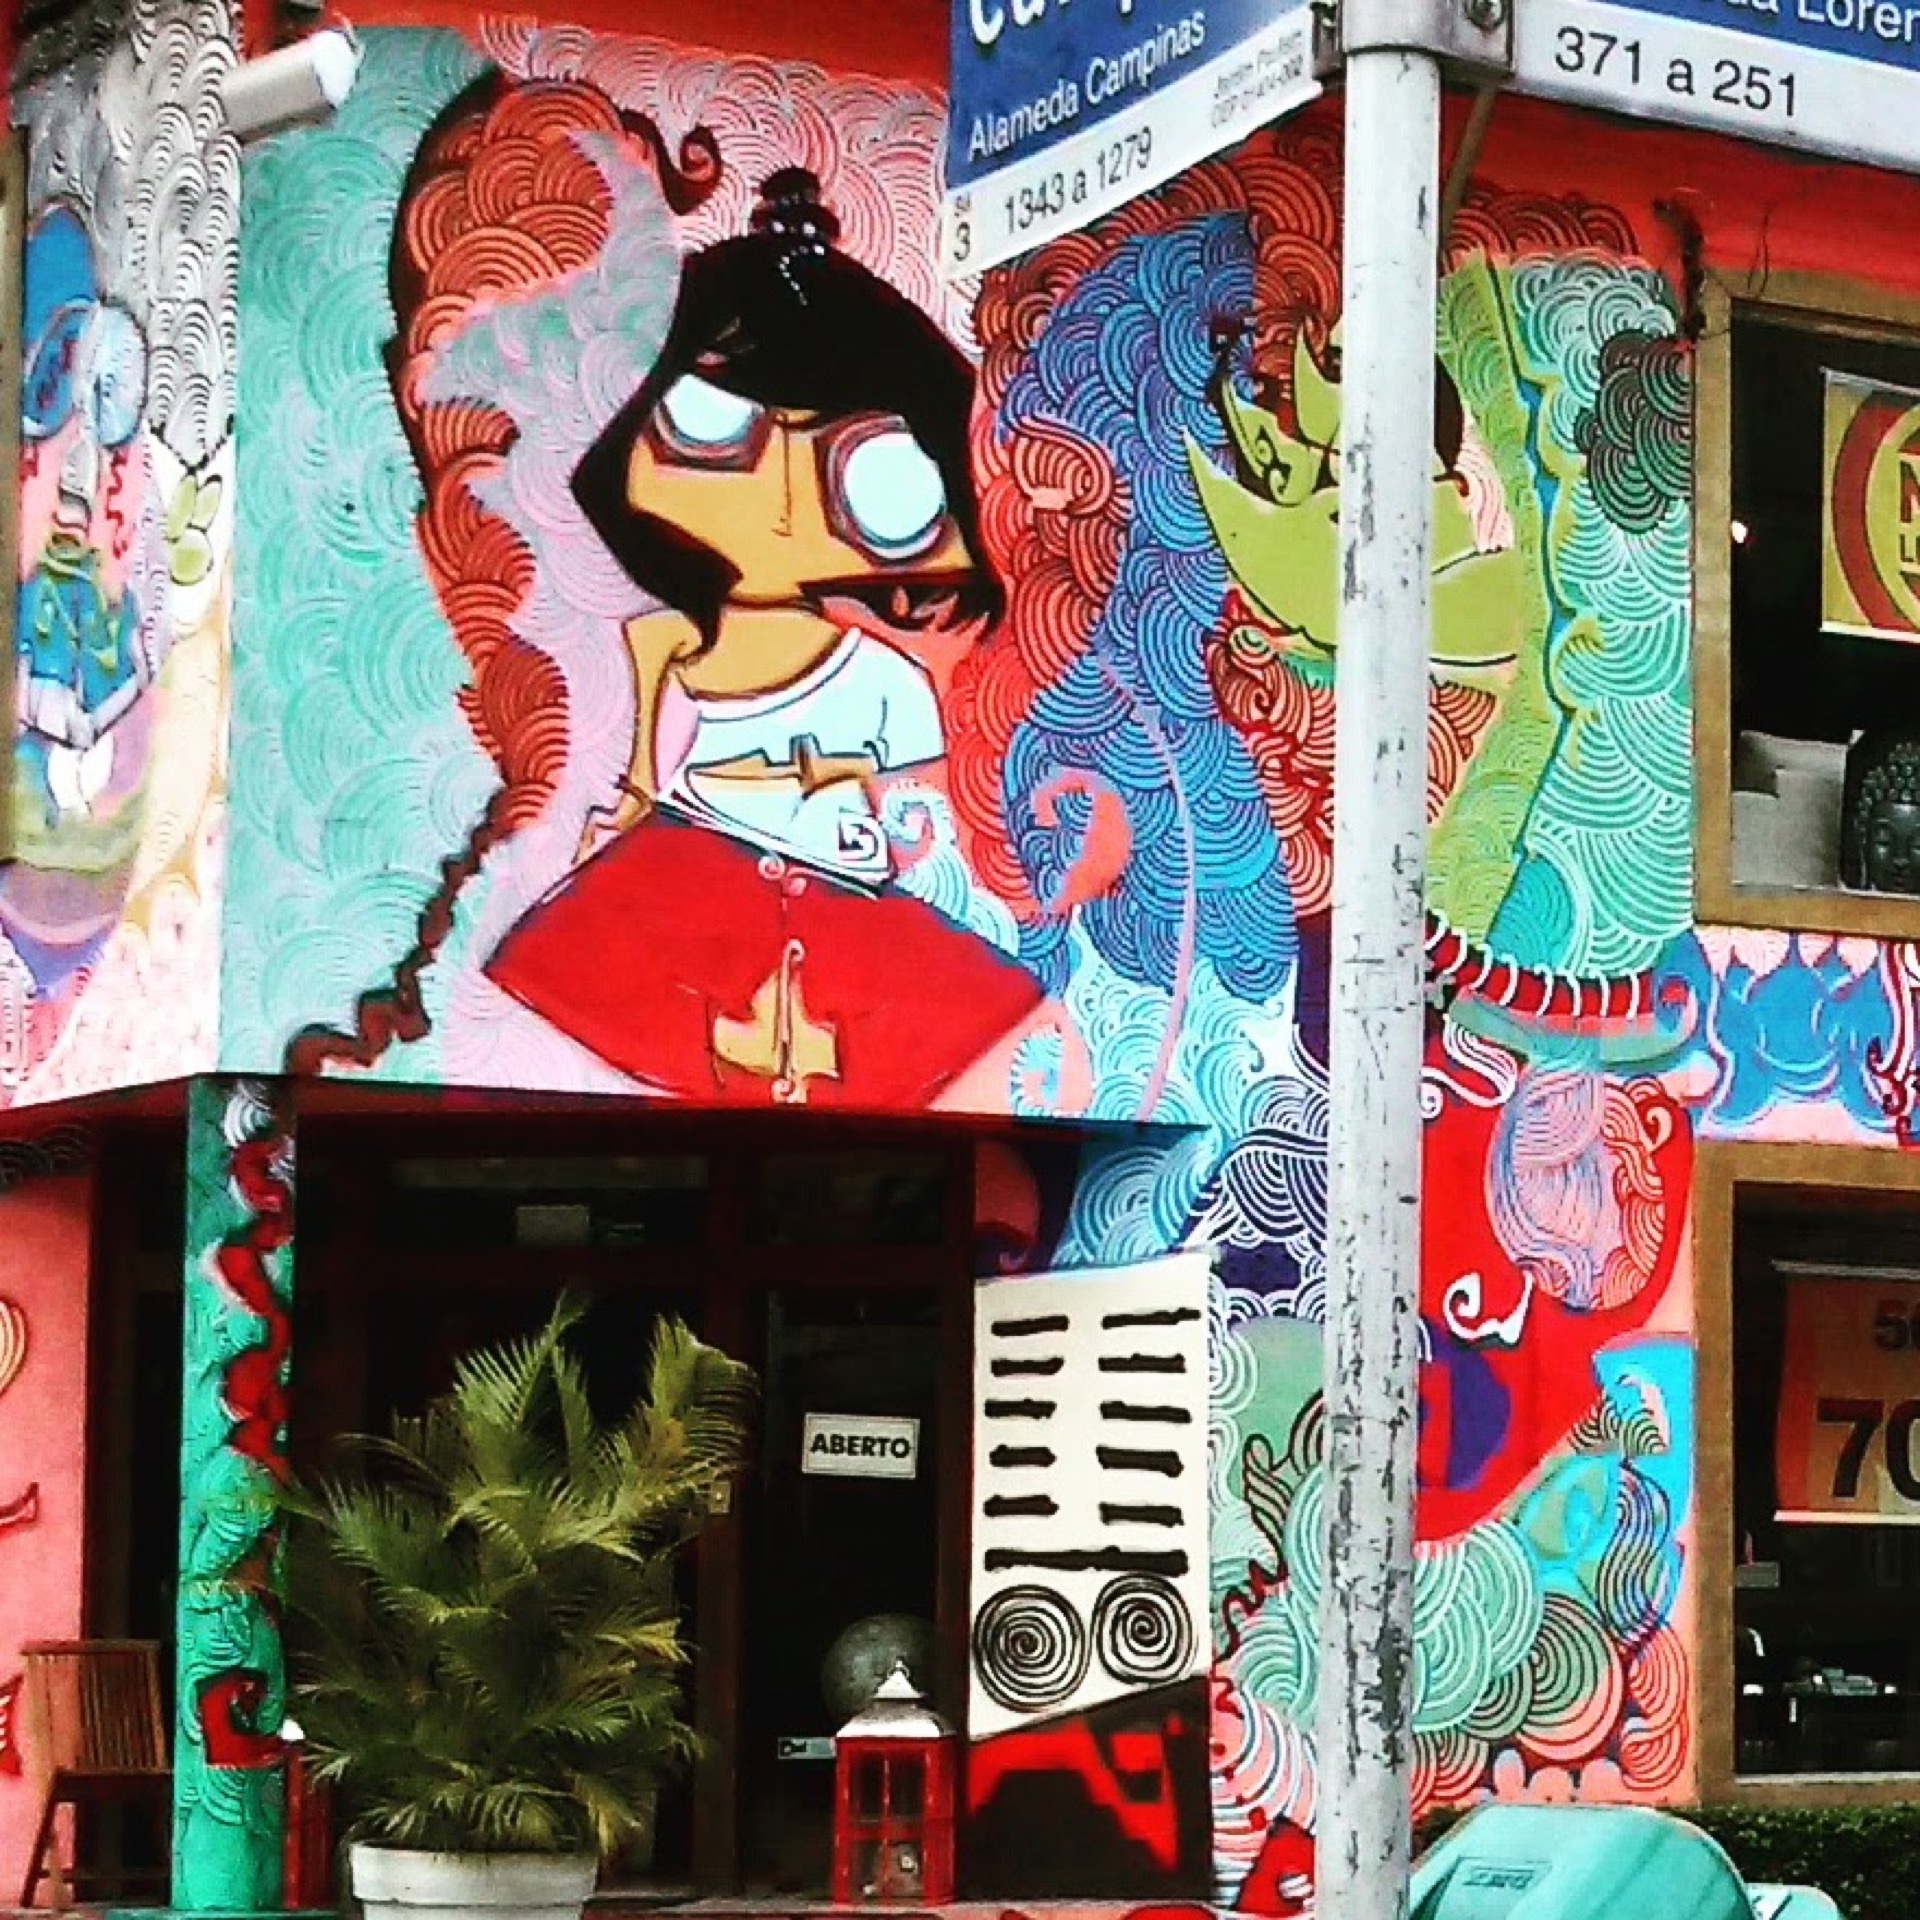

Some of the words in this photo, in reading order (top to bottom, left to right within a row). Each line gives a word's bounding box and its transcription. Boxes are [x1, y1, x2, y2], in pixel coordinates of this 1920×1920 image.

[967, 80, 1079, 162] Alameda
[1085, 10, 1205, 103] Campinas
[1554, 26, 1641, 84] 371
[1666, 58, 1695, 96] a
[1713, 60, 1798, 117] 251
[1004, 172, 1066, 236] 1343
[1071, 170, 1088, 206] a
[1097, 126, 1154, 190] 1279
[953, 221, 971, 262] 3
[810, 1433, 910, 1459] ABERTO
